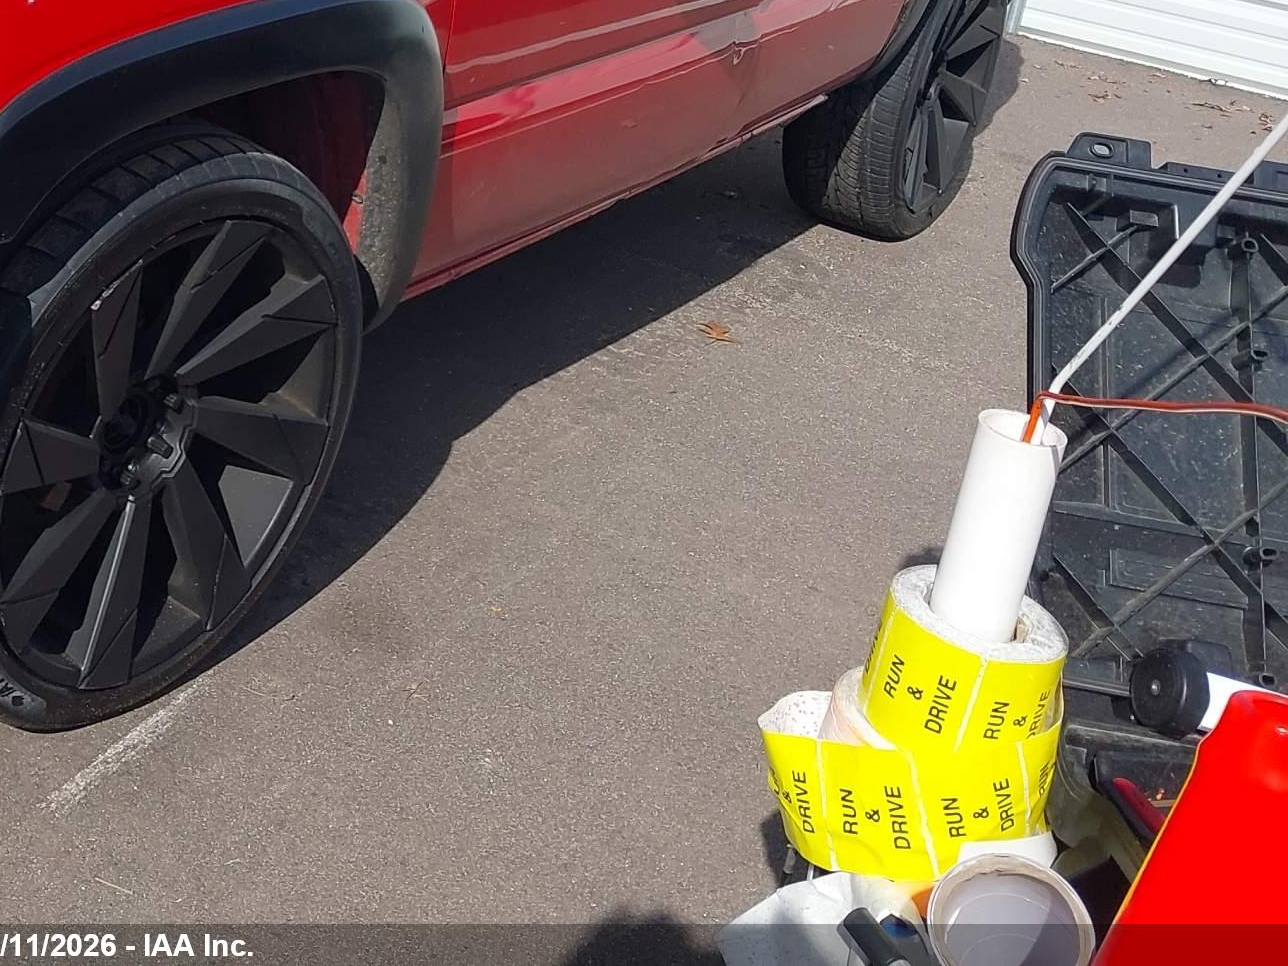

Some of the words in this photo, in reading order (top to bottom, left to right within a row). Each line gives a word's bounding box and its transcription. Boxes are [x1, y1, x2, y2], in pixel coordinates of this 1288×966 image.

[883, 654, 905, 699] RUN
[906, 686, 924, 701] &
[924, 675, 957, 734] DRIVE
[983, 701, 1010, 740] RUN
[1012, 715, 1029, 727] &
[792, 770, 816, 834] DRIVE
[840, 788, 859, 835] RUN
[865, 809, 881, 823] &
[884, 786, 912, 850] DRIVE
[940, 798, 967, 838] RUN
[973, 806, 989, 819] &
[993, 778, 1015, 832] DRIVE
